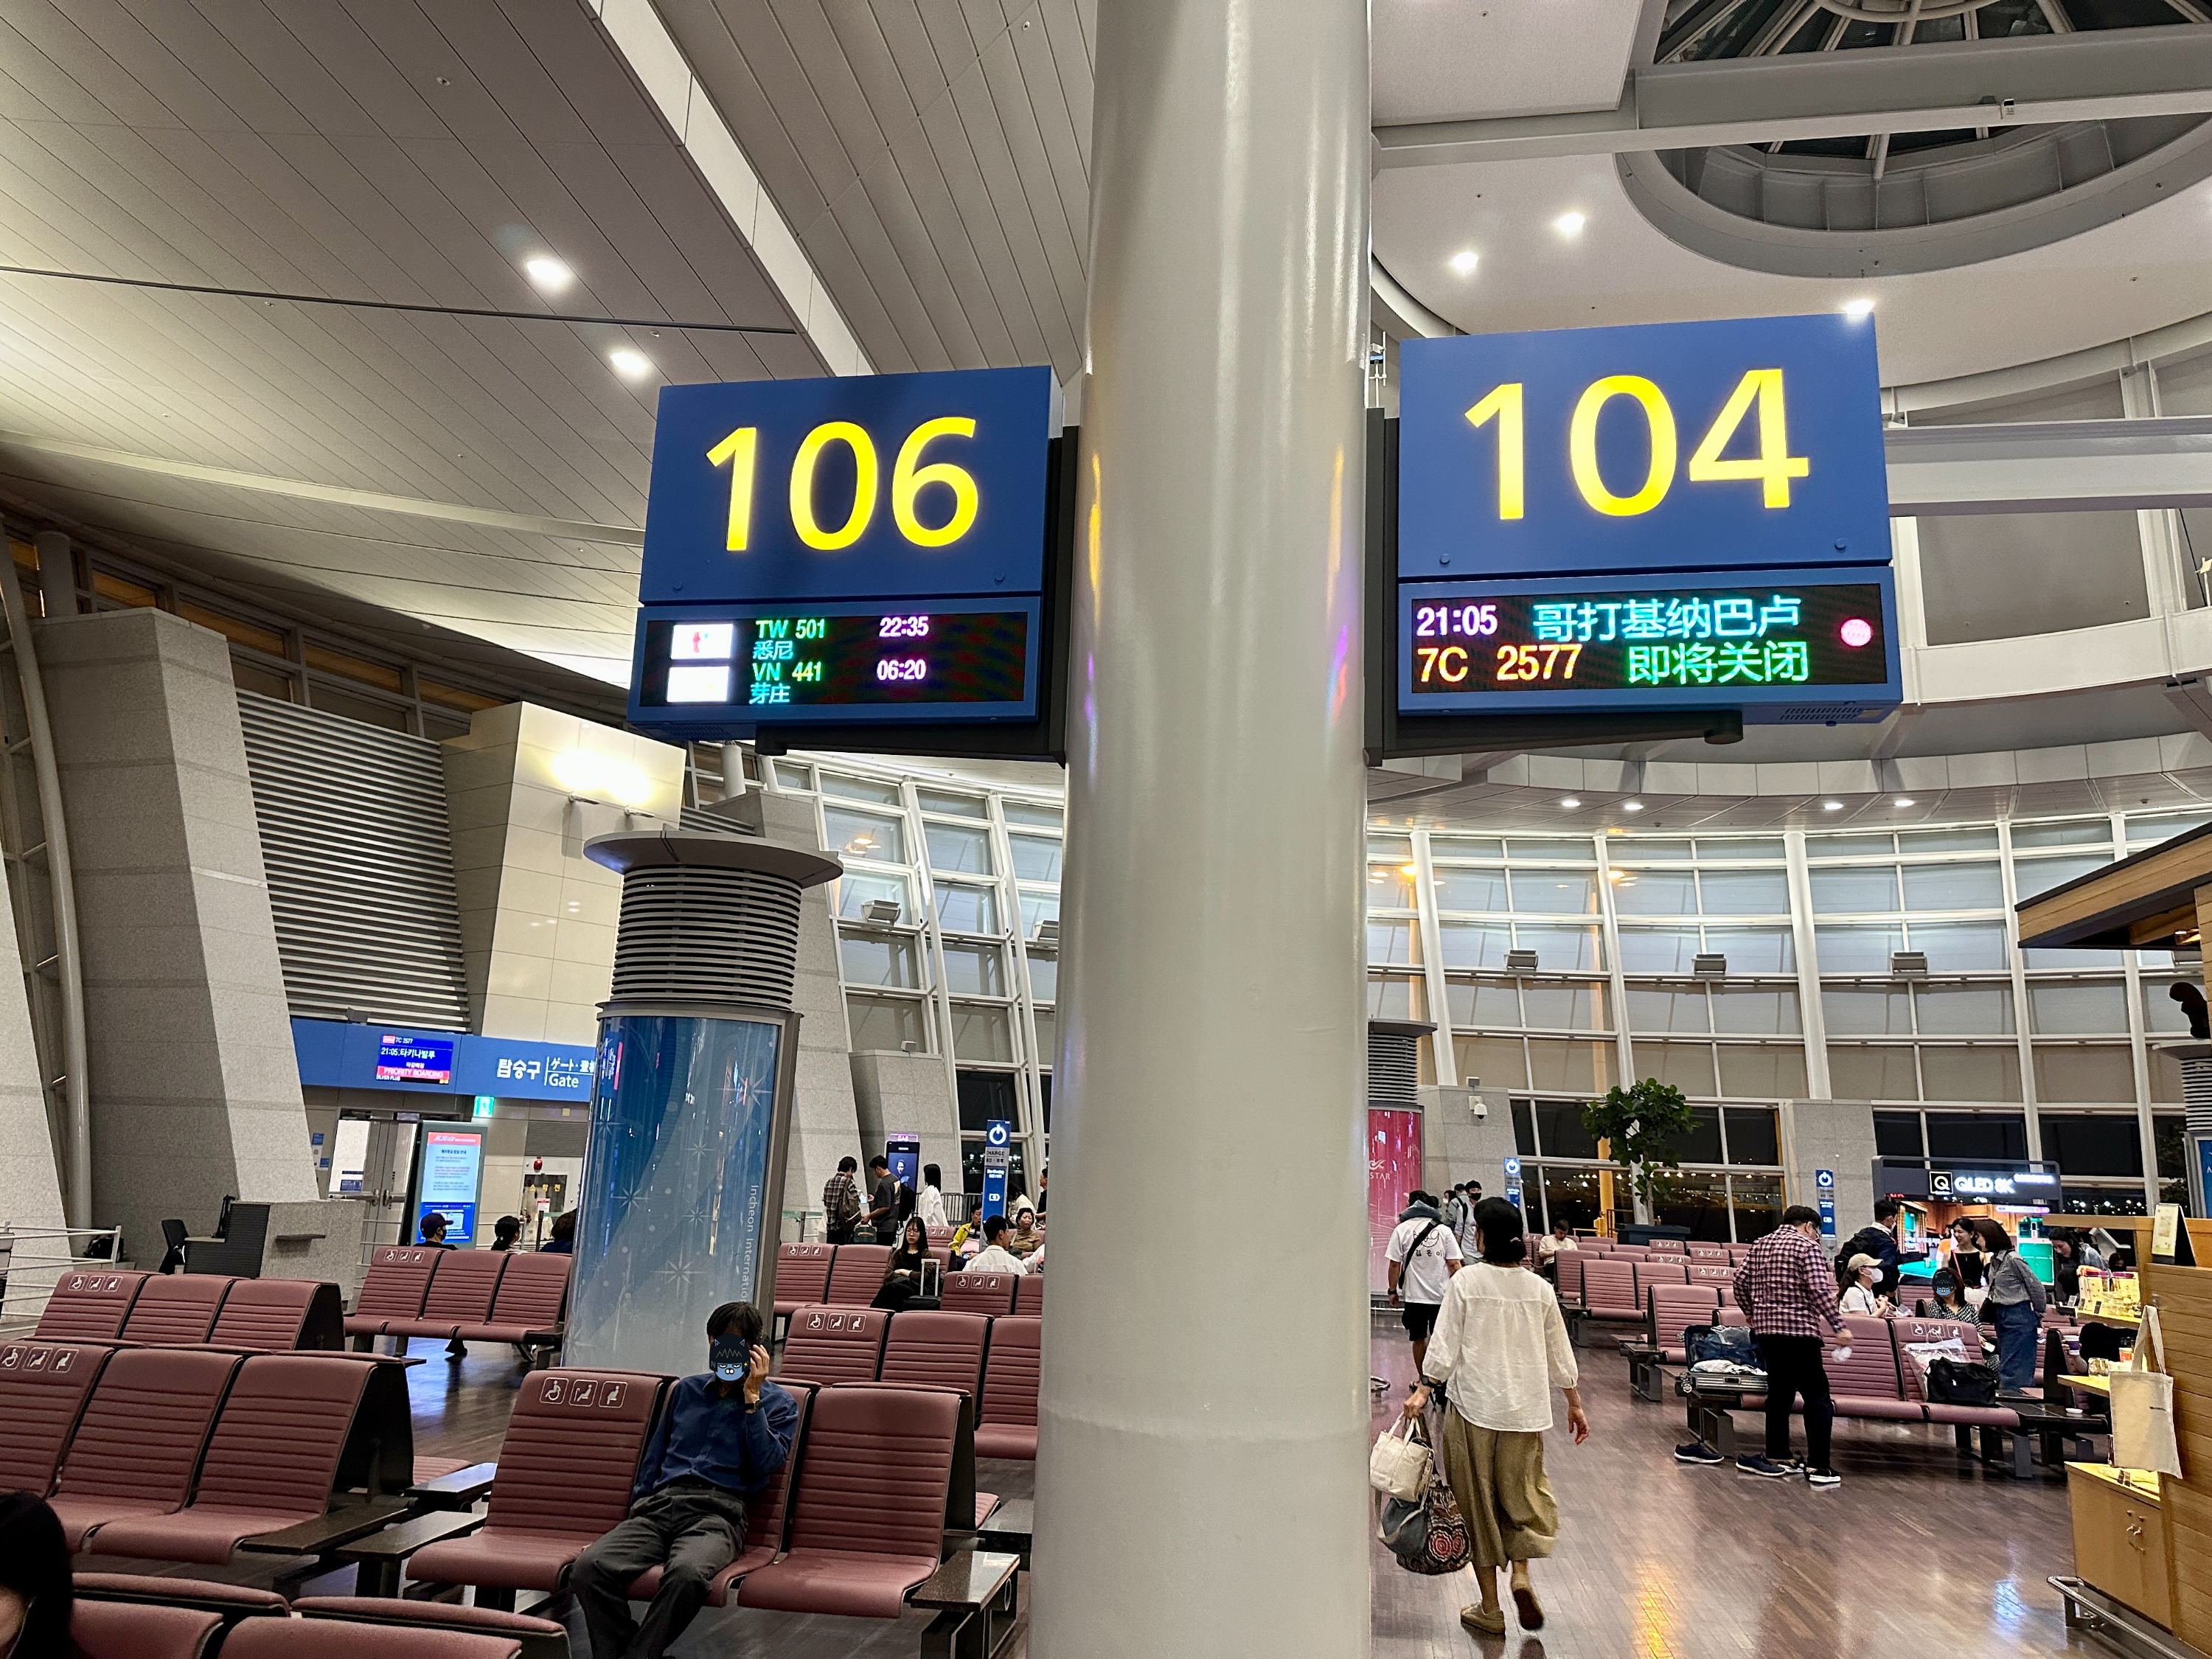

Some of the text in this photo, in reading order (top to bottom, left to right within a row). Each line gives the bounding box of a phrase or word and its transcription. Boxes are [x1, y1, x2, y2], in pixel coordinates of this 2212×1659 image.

[1464, 367, 1809, 521] 104
[706, 416, 979, 552] 106
[755, 616, 930, 639] TW 501 22:35
[1416, 594, 1802, 643] 21:05 哥打基纳巴卢
[752, 640, 793, 661] 悉尼
[752, 659, 926, 681] VN 441 06:20
[1416, 640, 1809, 686] 7C 2577 即将关闭
[748, 683, 790, 705] 芽庄
[383, 1067, 444, 1077] PRIORITY BOARDING
[496, 1058, 541, 1080] 탑승구
[549, 1073, 580, 1088] Gate
[1934, 1175, 1950, 1191] Q
[1955, 1177, 1994, 1193] QLED
[747, 1185, 759, 1232] Incheon
